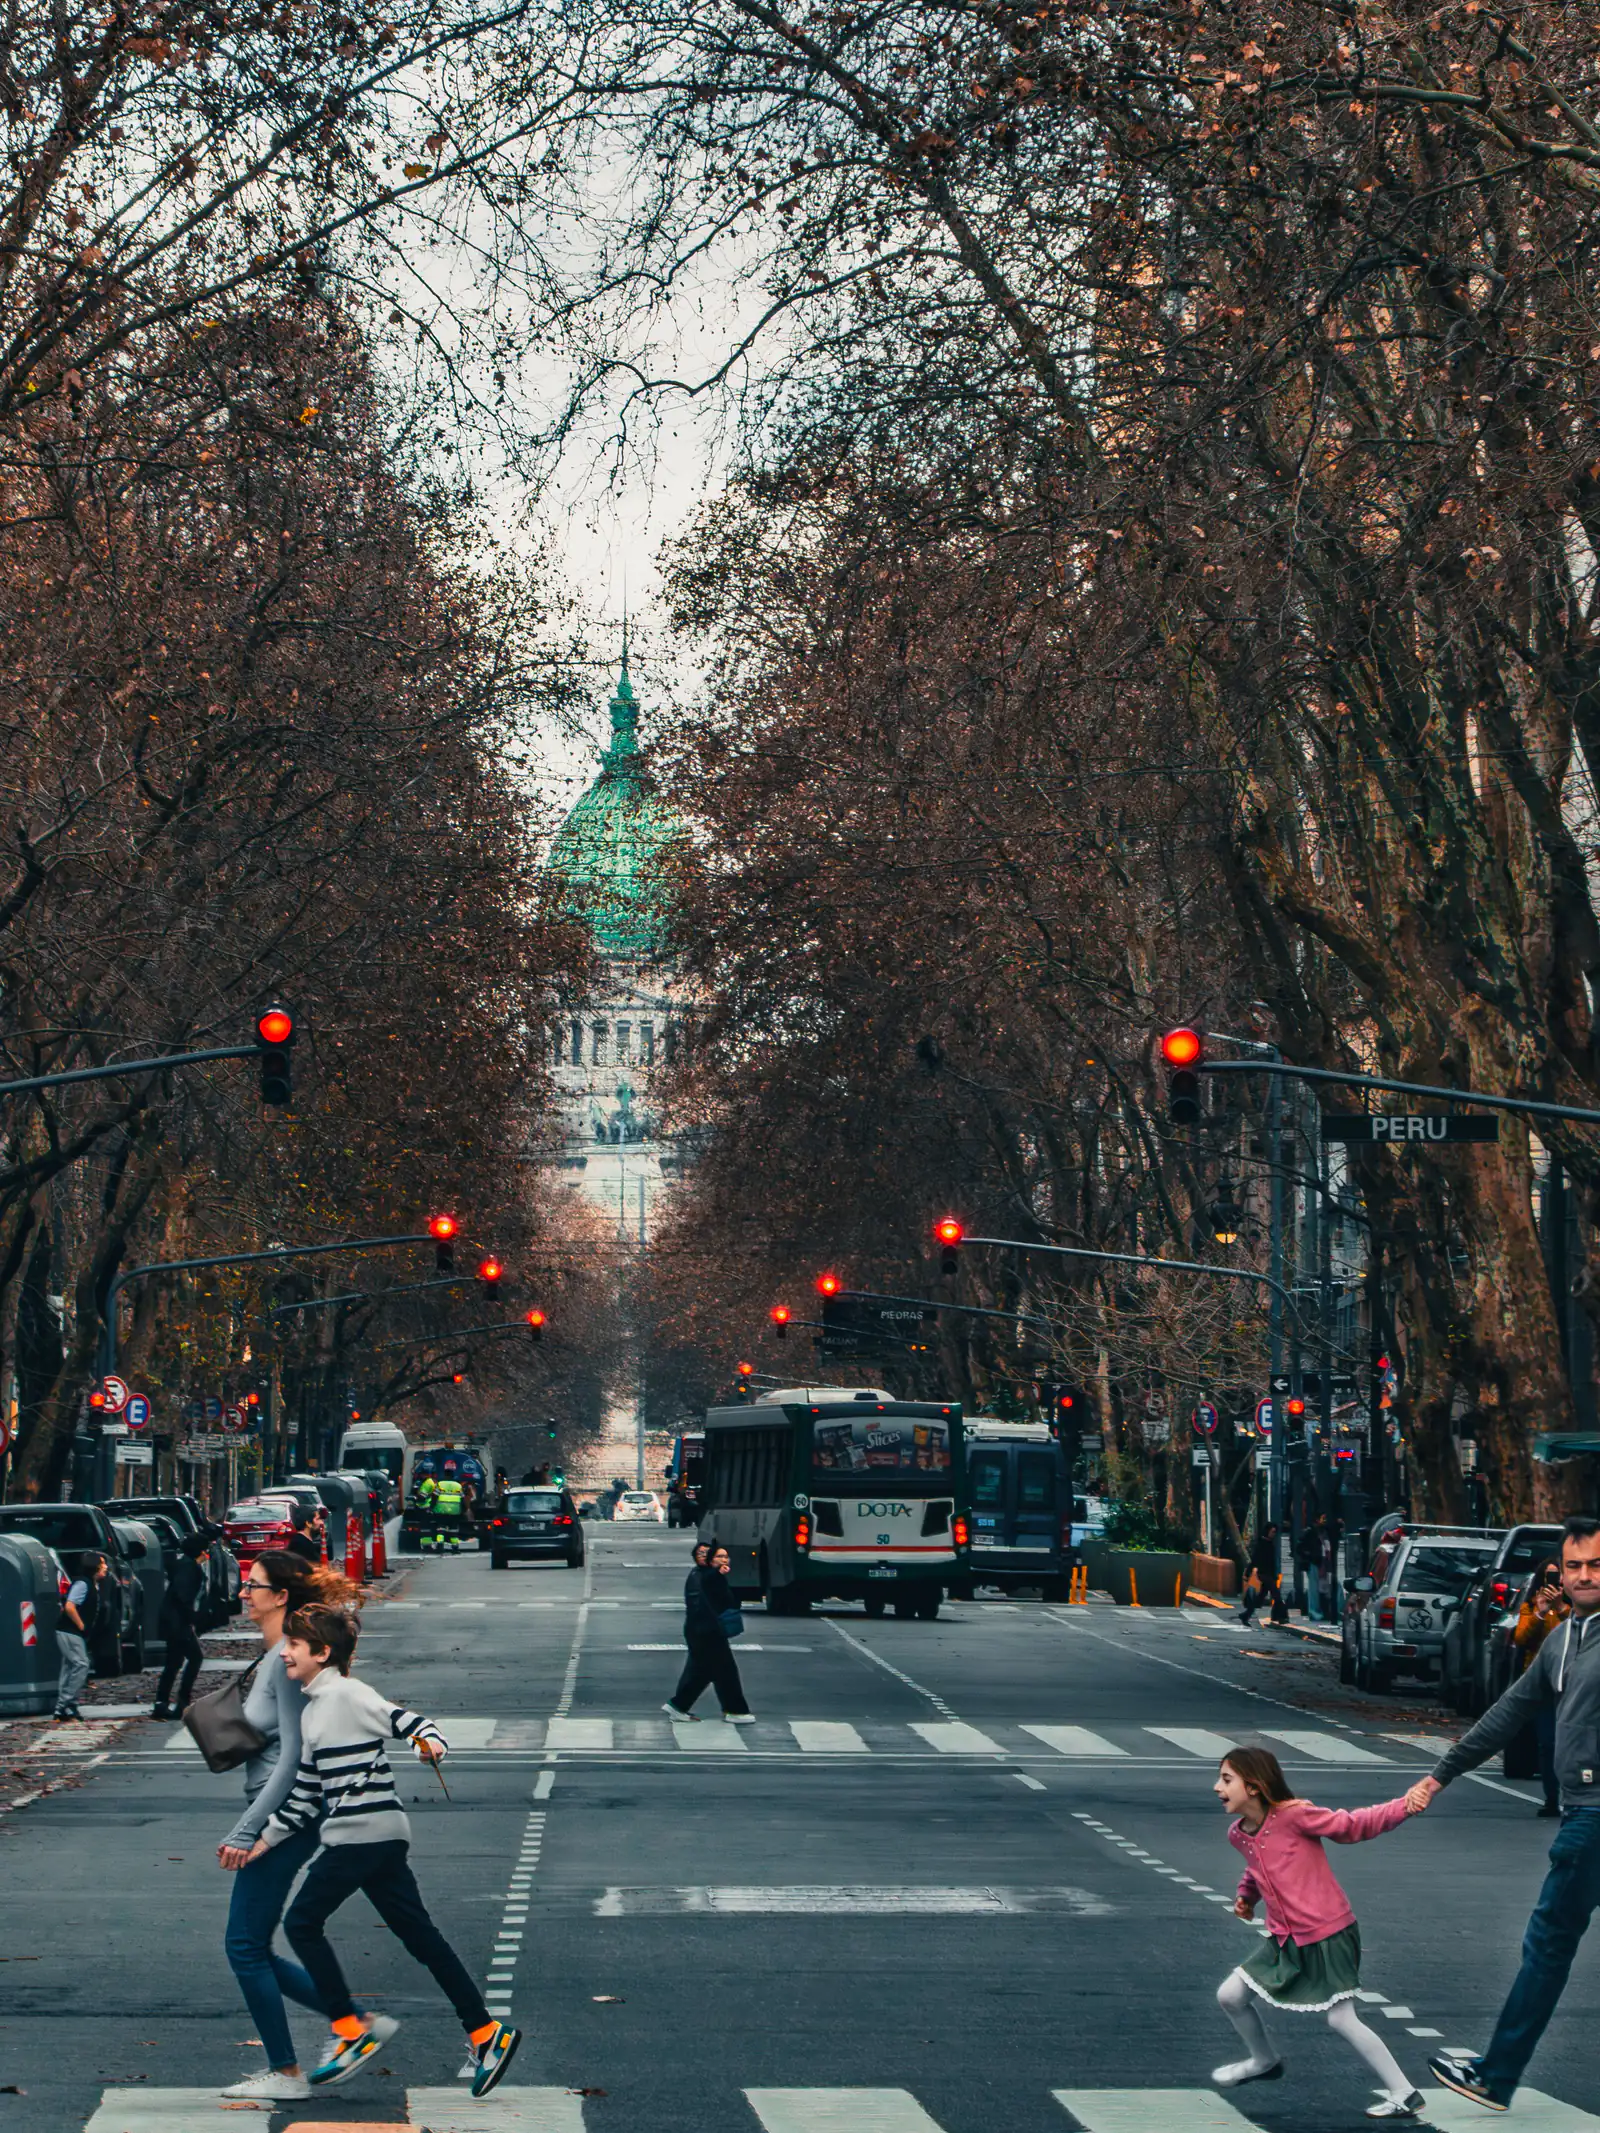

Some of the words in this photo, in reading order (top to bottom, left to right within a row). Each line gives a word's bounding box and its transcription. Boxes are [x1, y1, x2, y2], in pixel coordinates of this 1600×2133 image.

[1372, 1117, 1447, 1140] PERU
[880, 1310, 924, 1320] PIEDRAS
[130, 1400, 144, 1424] E
[1261, 1405, 1273, 1427] E
[866, 1430, 901, 1449] Slices
[796, 1496, 807, 1507] 60
[858, 1503, 912, 1518] DOTA
[876, 1534, 890, 1545] 50
